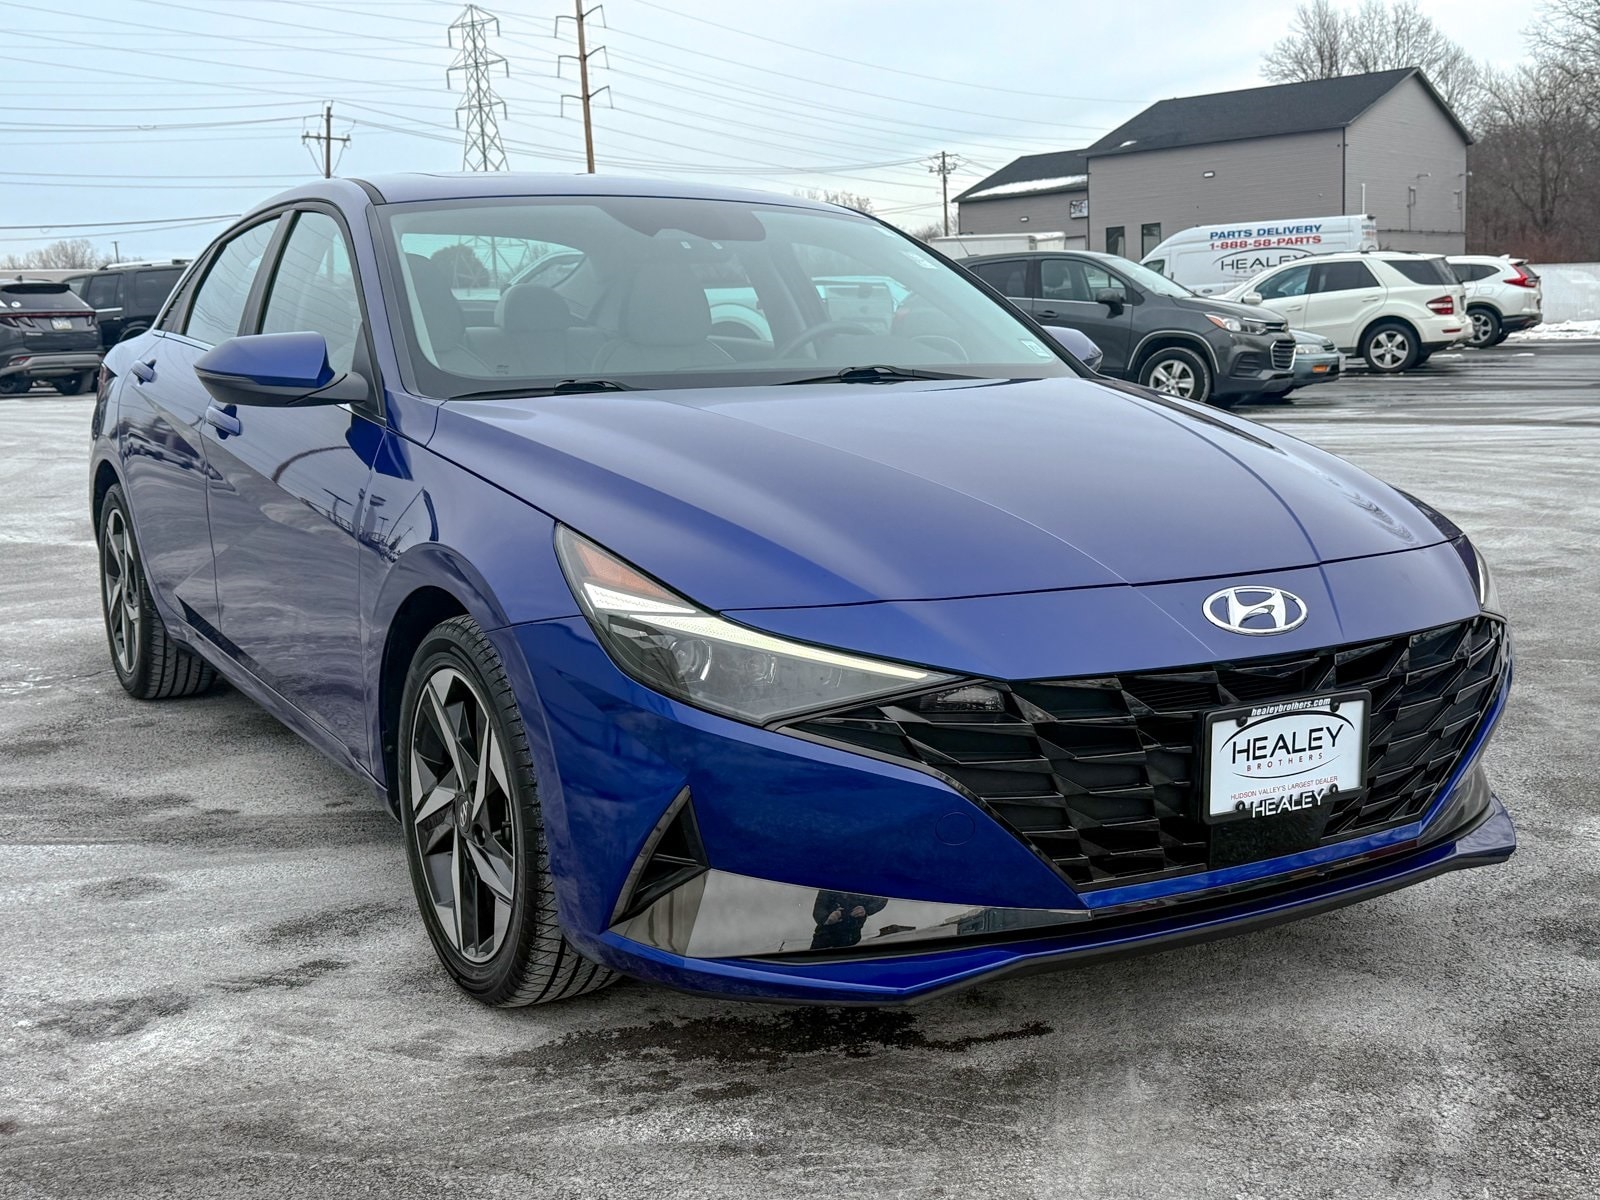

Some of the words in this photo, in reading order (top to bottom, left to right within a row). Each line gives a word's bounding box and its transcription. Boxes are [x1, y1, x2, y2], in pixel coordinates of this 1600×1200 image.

[1210, 229, 1252, 240] PARTS
[1257, 224, 1322, 236] DELIVERY
[1209, 235, 1322, 250] 1-888-58-PARTS
[1251, 698, 1331, 716] healeybrothers.com
[1232, 724, 1344, 764] HEALEY
[1246, 752, 1323, 772] BROTHERS
[1230, 790, 1257, 800] HUDSON
[1258, 784, 1286, 795] VALLEY'S
[1287, 780, 1314, 790] LARGEST
[1315, 776, 1338, 785] DEALER
[1251, 788, 1325, 818] HEALEY
